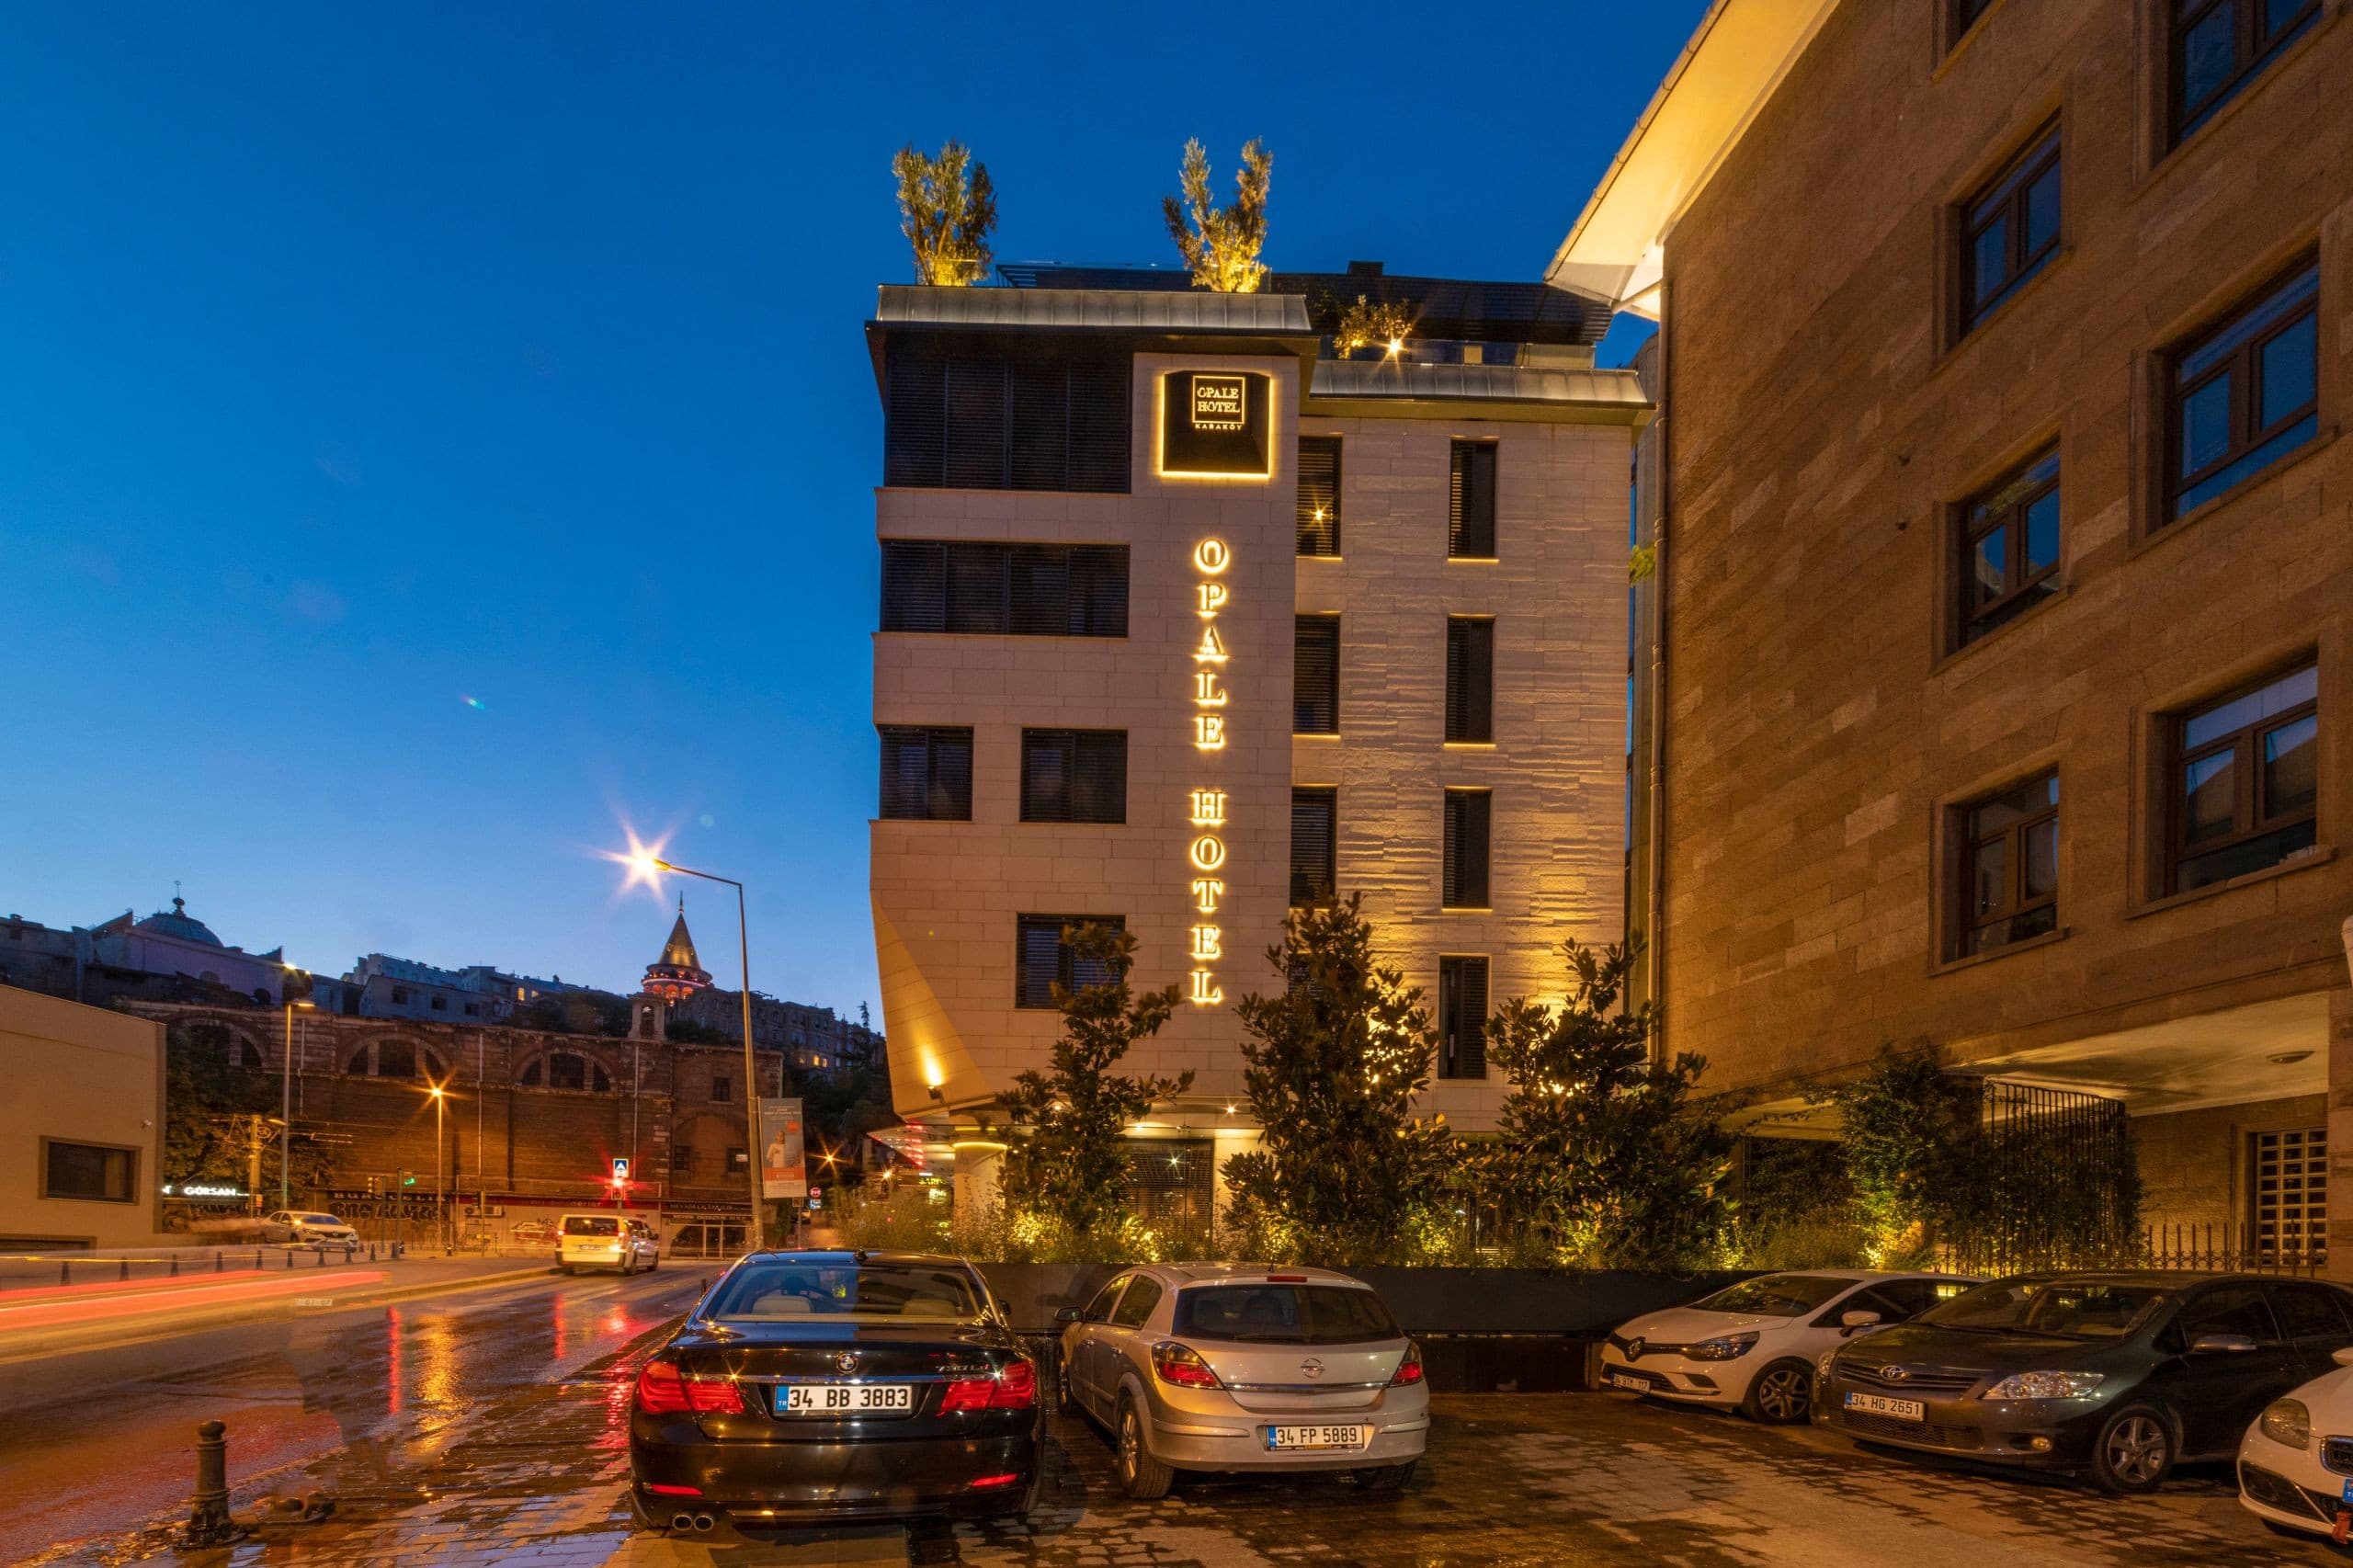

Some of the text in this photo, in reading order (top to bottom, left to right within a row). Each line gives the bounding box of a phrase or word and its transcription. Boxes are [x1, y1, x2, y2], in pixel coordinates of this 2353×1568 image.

[1198, 387, 1239, 398] OPALE
[1198, 401, 1240, 412] HOTEL
[1192, 538, 1228, 1003] OPALE HOTEL
[790, 1388, 908, 1408] 34 BB 3883
[1852, 1394, 1866, 1407] 34
[1870, 1397, 1885, 1410] HG
[1890, 1400, 1920, 1415] 2651
[1278, 1427, 1357, 1444] 34 FP 5889
